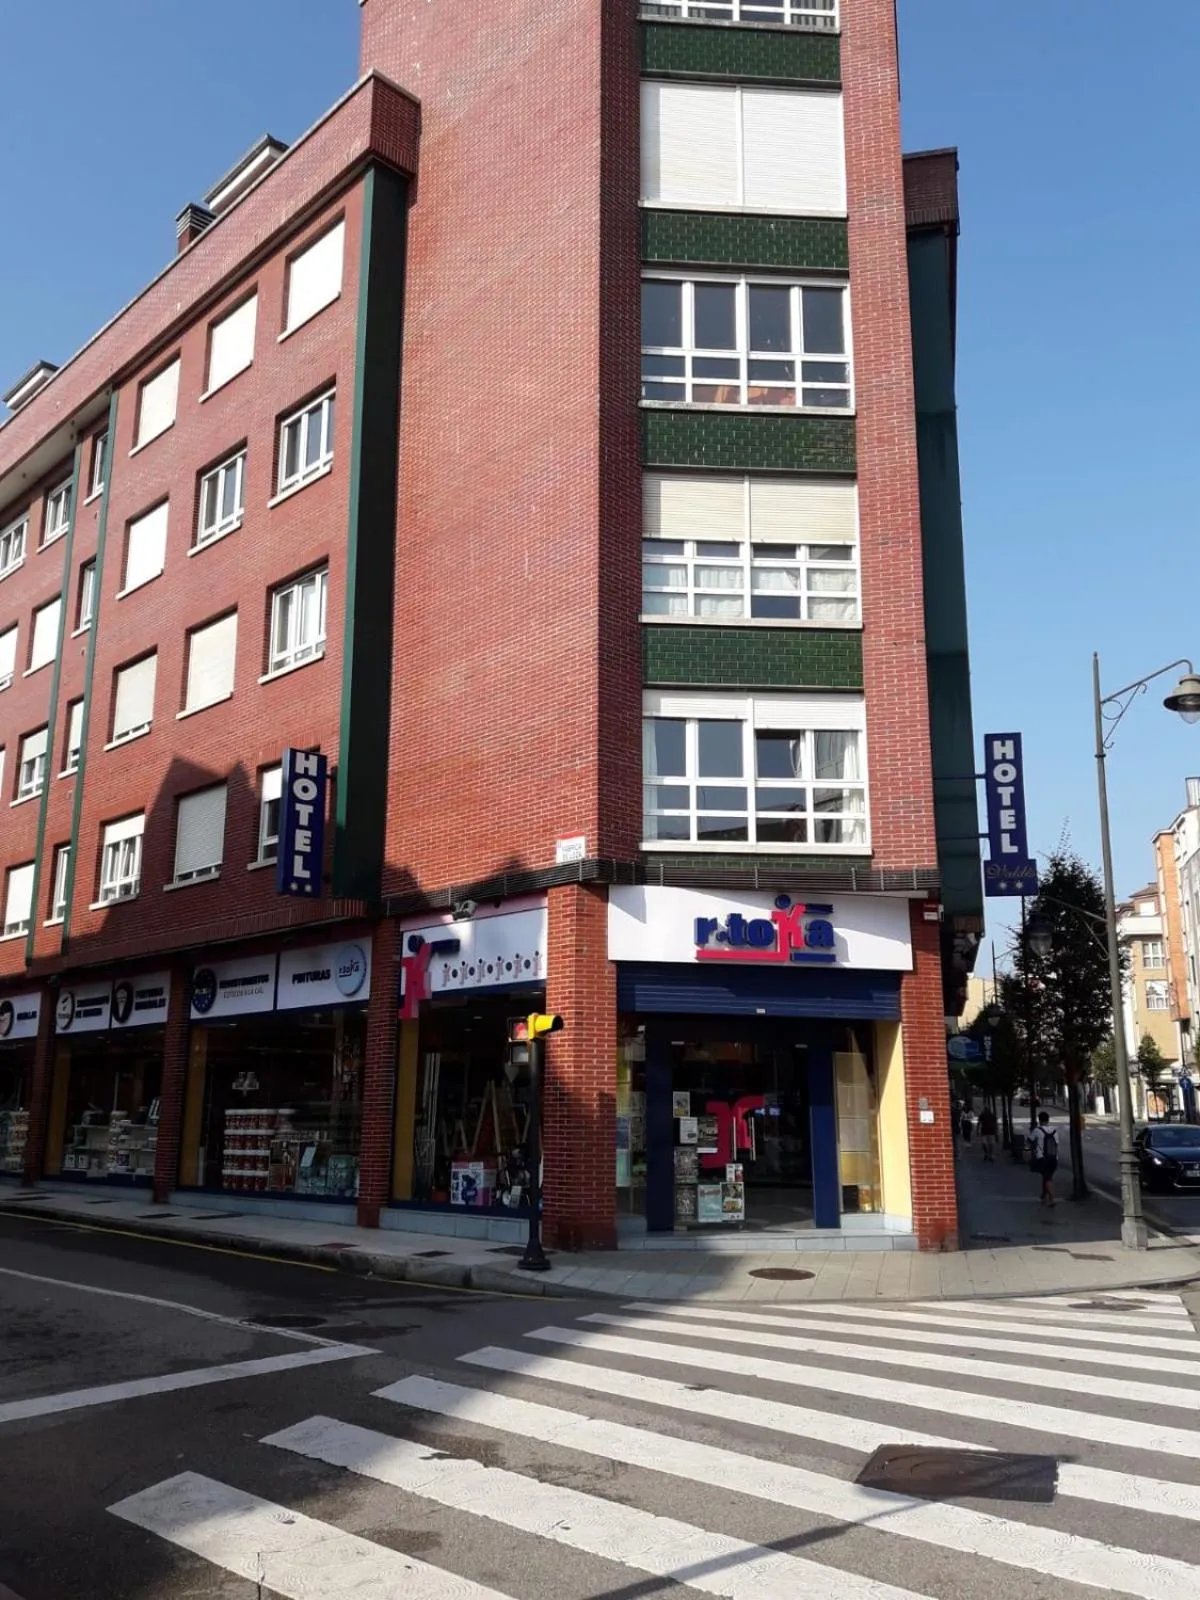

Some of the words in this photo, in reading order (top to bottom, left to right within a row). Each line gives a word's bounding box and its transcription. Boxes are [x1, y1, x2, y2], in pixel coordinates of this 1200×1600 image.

[293, 752, 318, 879] HOTEL
[993, 740, 1018, 853] HOTEL
[292, 969, 331, 985] PINTURAS
